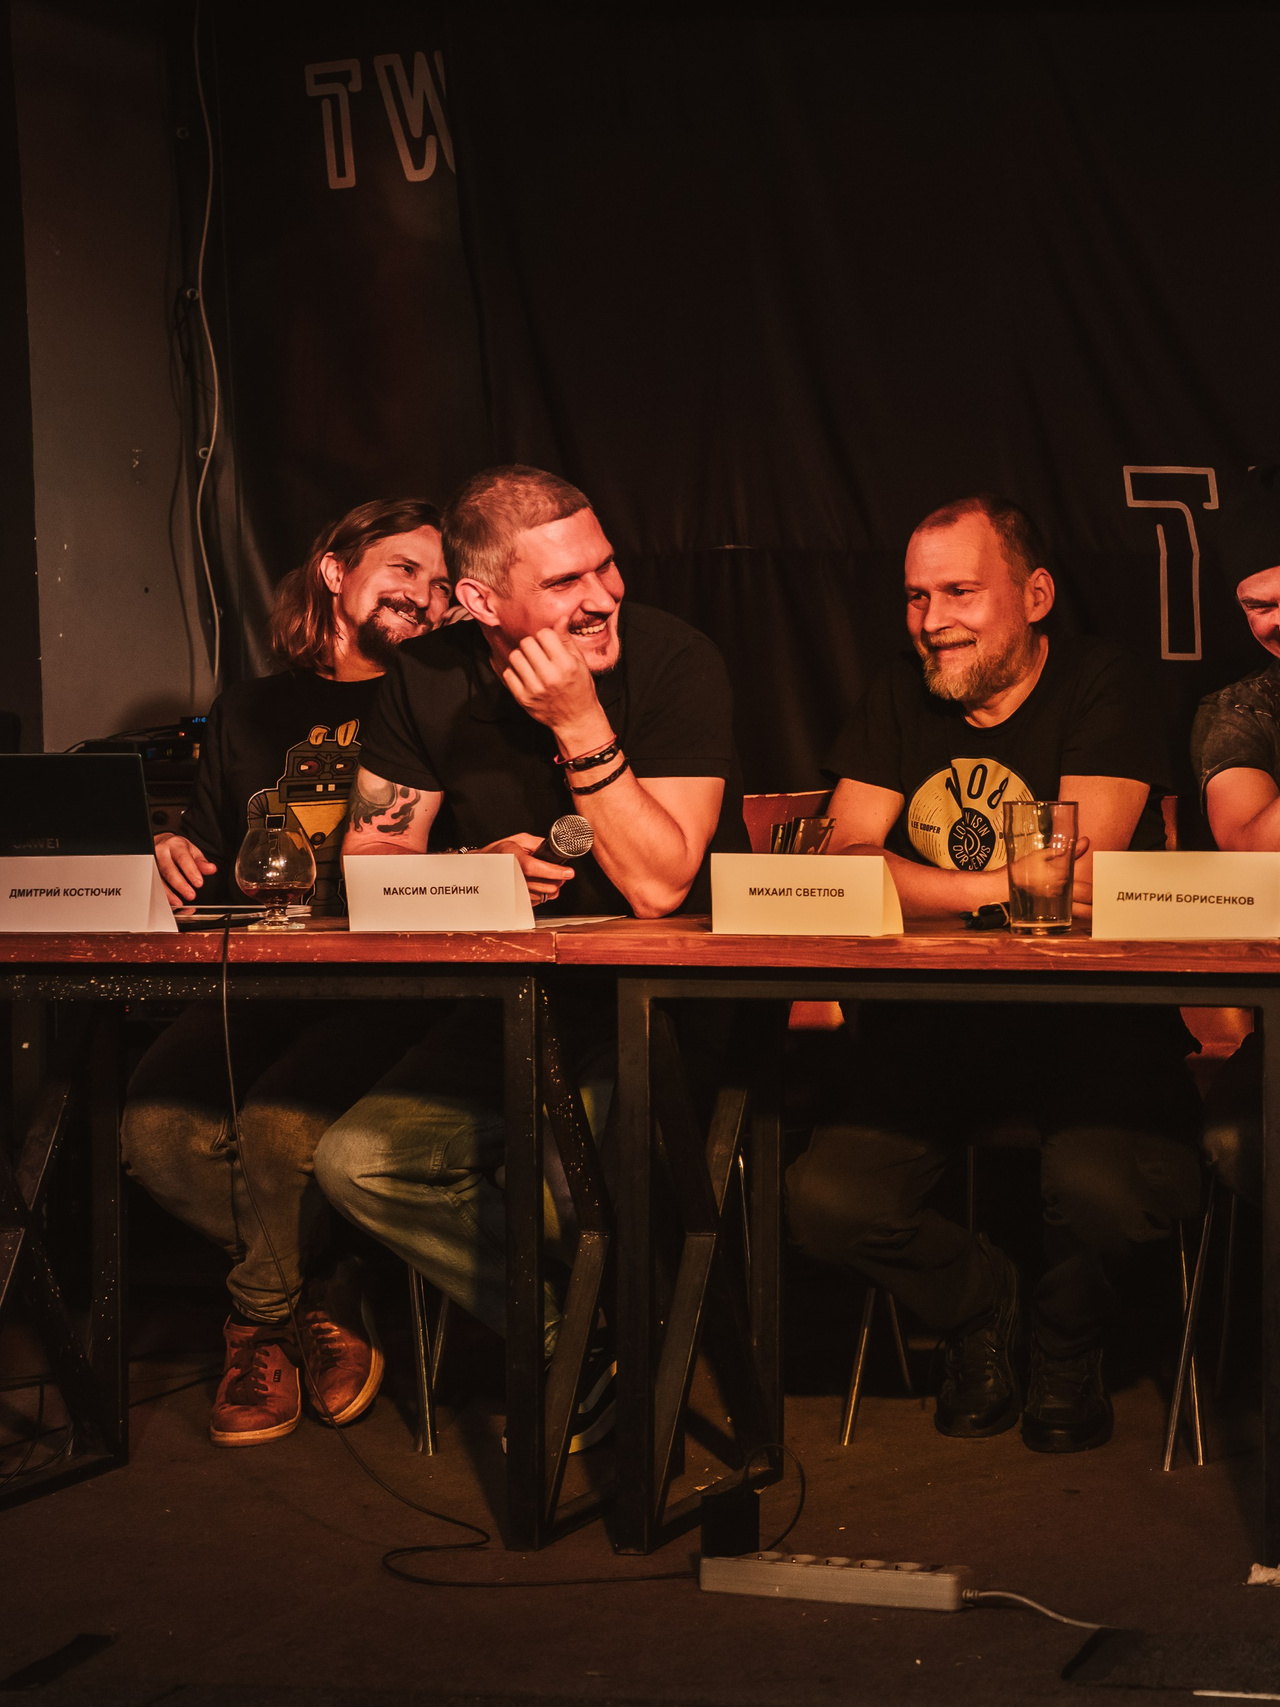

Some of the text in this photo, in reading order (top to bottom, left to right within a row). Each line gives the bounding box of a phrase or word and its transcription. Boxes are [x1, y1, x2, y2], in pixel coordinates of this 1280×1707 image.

[911, 820, 941, 834] LEE COOPER
[971, 814, 982, 828] IS
[977, 823, 990, 837] IN
[952, 845, 969, 866] OUR
[9, 887, 122, 899] ДМИТРИЙ КОСТЮЧИК
[383, 885, 480, 896] МАКСИМ ОЛЕЙНИК
[748, 887, 845, 898] МИХАИЛ СВЕТЛОВ
[1116, 891, 1255, 906] ДМИТРИЙ БОРИСЕНКОВ
